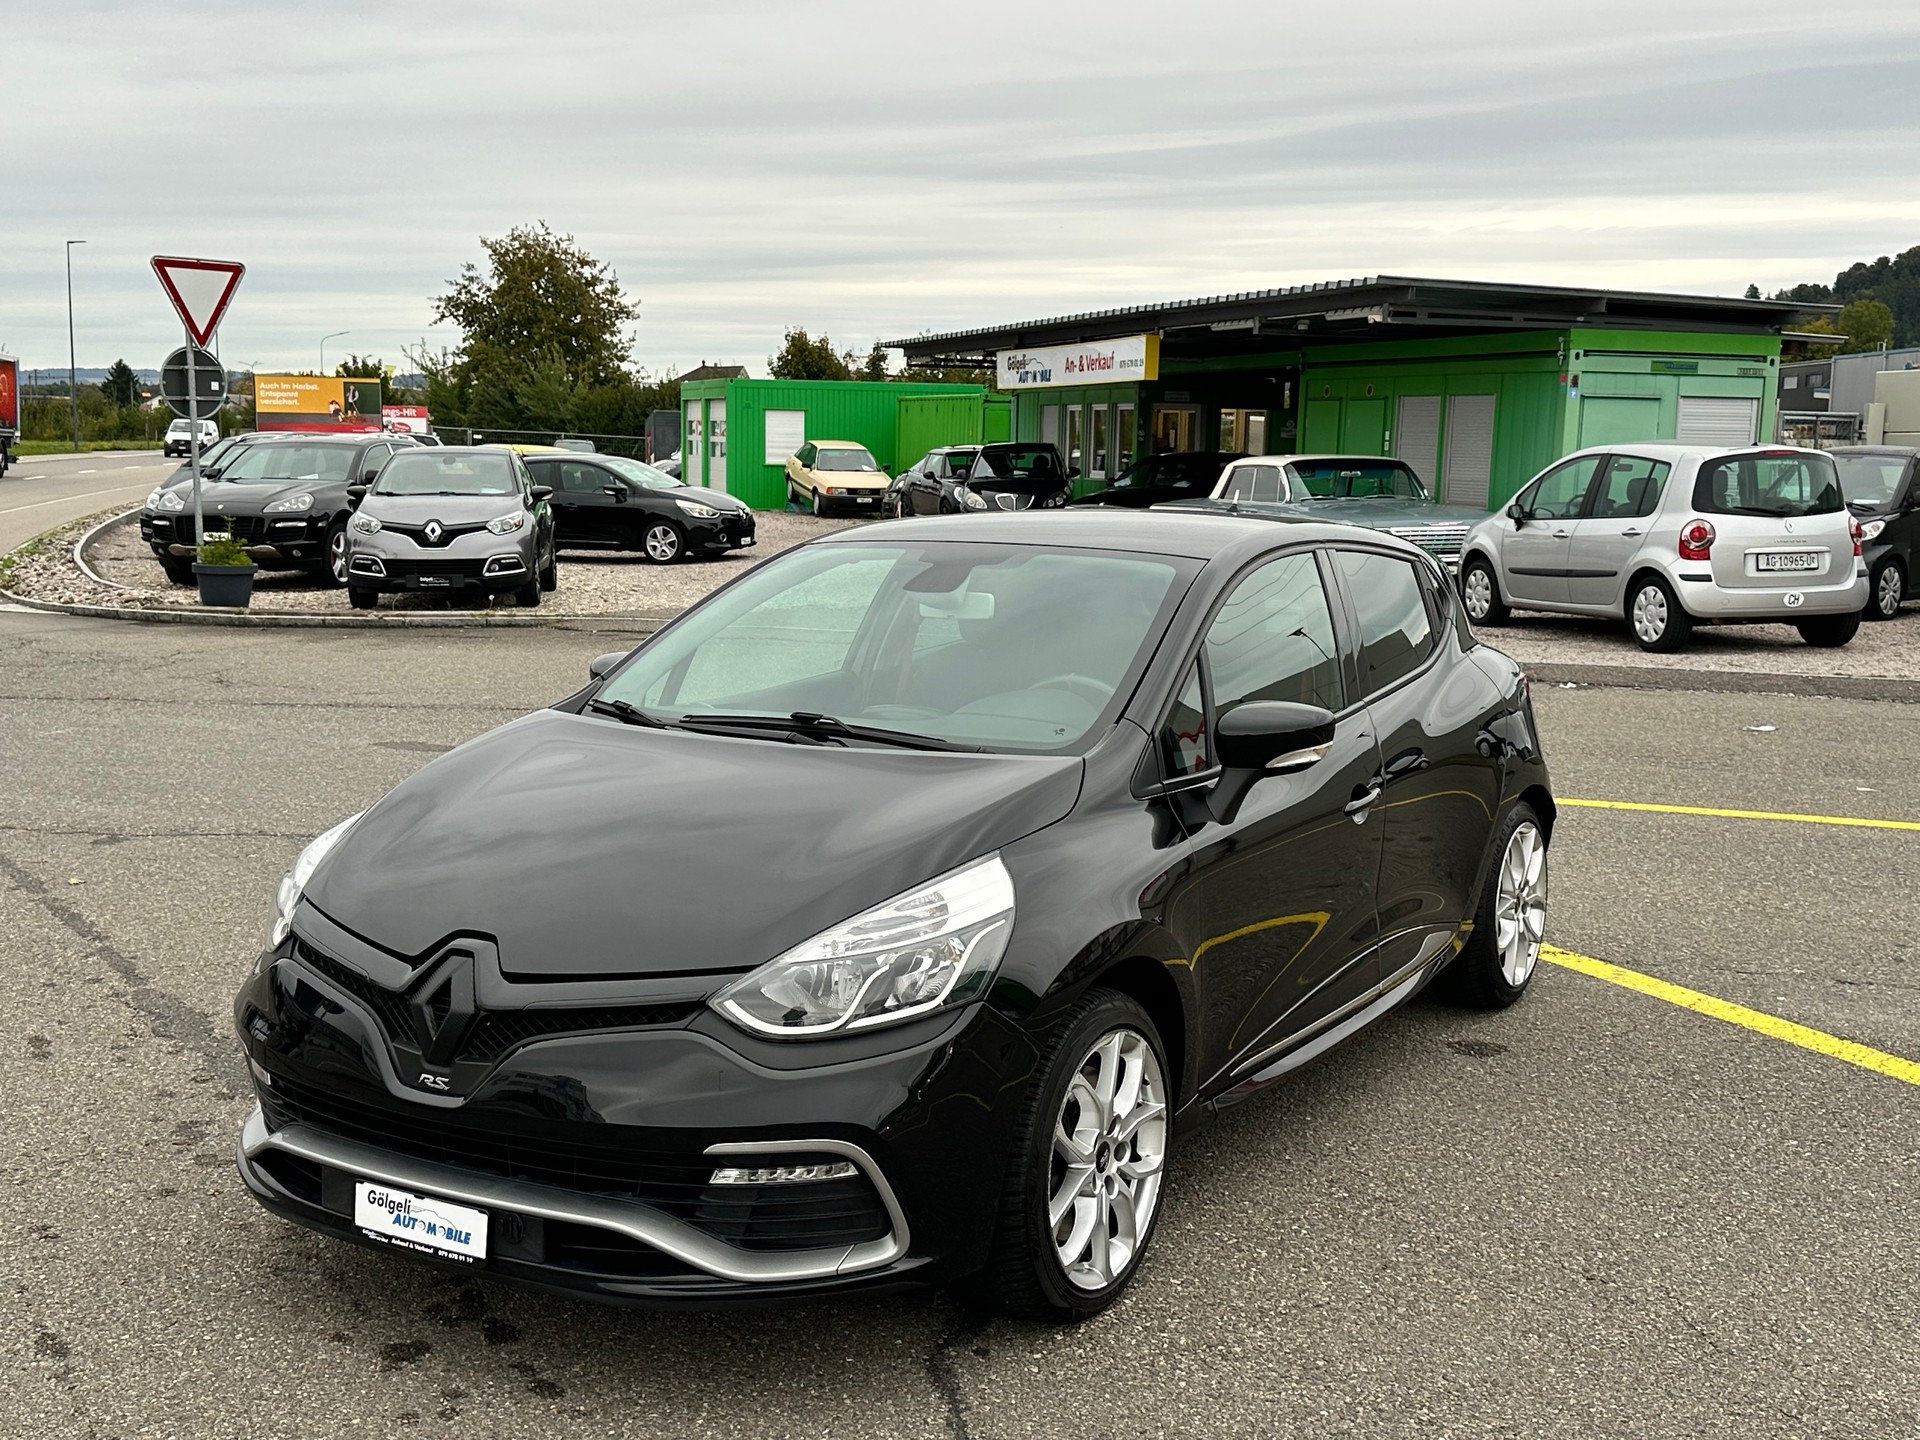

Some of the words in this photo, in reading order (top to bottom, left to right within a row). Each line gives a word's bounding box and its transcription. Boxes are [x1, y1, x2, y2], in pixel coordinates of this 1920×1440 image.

[1007, 354, 1026, 374] Gölgeli
[1065, 357, 1077, 373] An-
[1078, 355, 1085, 372] &
[1086, 351, 1115, 372] Verkauf
[260, 382, 279, 390] Auch
[260, 391, 299, 399] Entspannt
[1788, 594, 1800, 605] CH
[418, 1073, 451, 1091] RS
[368, 1190, 412, 1215] Gölgeli
[393, 1213, 472, 1245] AUTOMOBILE
